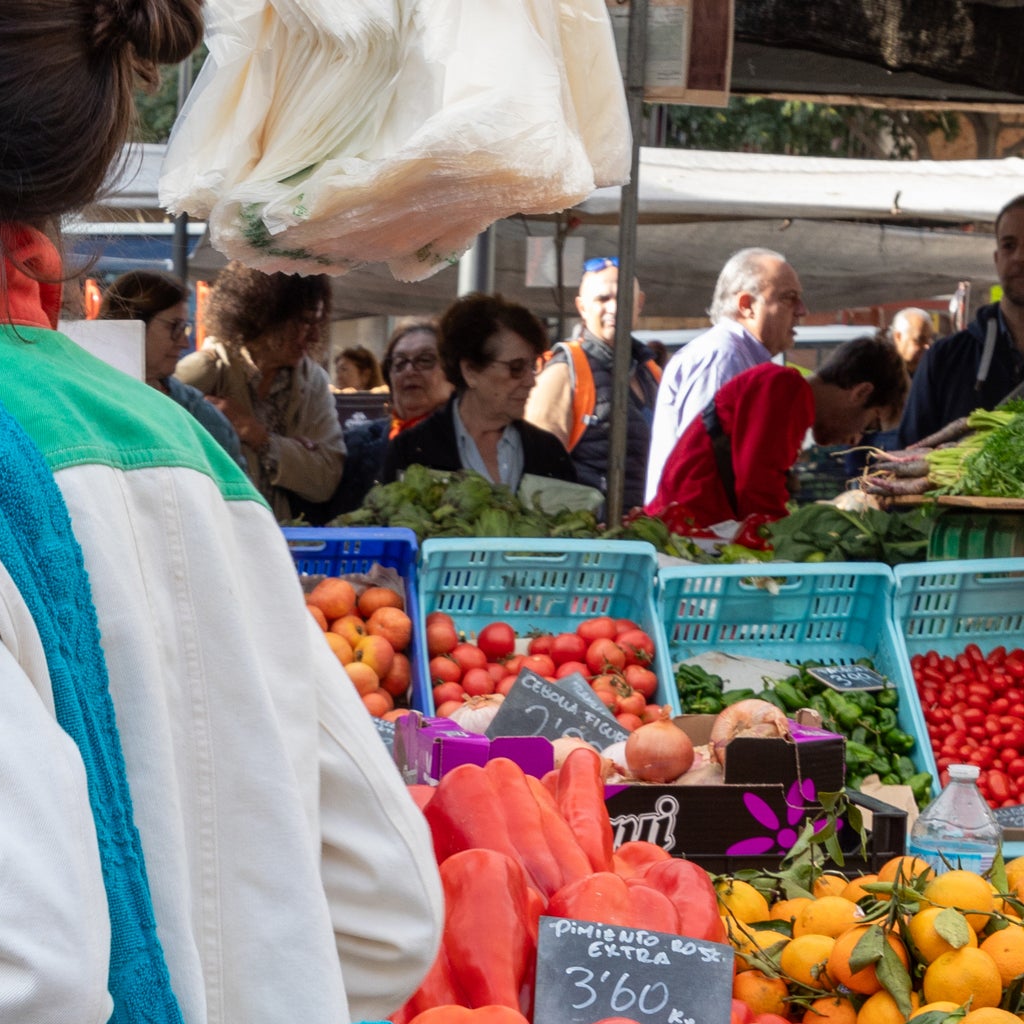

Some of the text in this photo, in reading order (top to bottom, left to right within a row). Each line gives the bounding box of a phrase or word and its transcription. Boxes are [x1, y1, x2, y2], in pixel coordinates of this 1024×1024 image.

[549, 919, 660, 947] PIMIENTO
[587, 941, 672, 965] EXTRA
[566, 966, 670, 1015] 3'60
